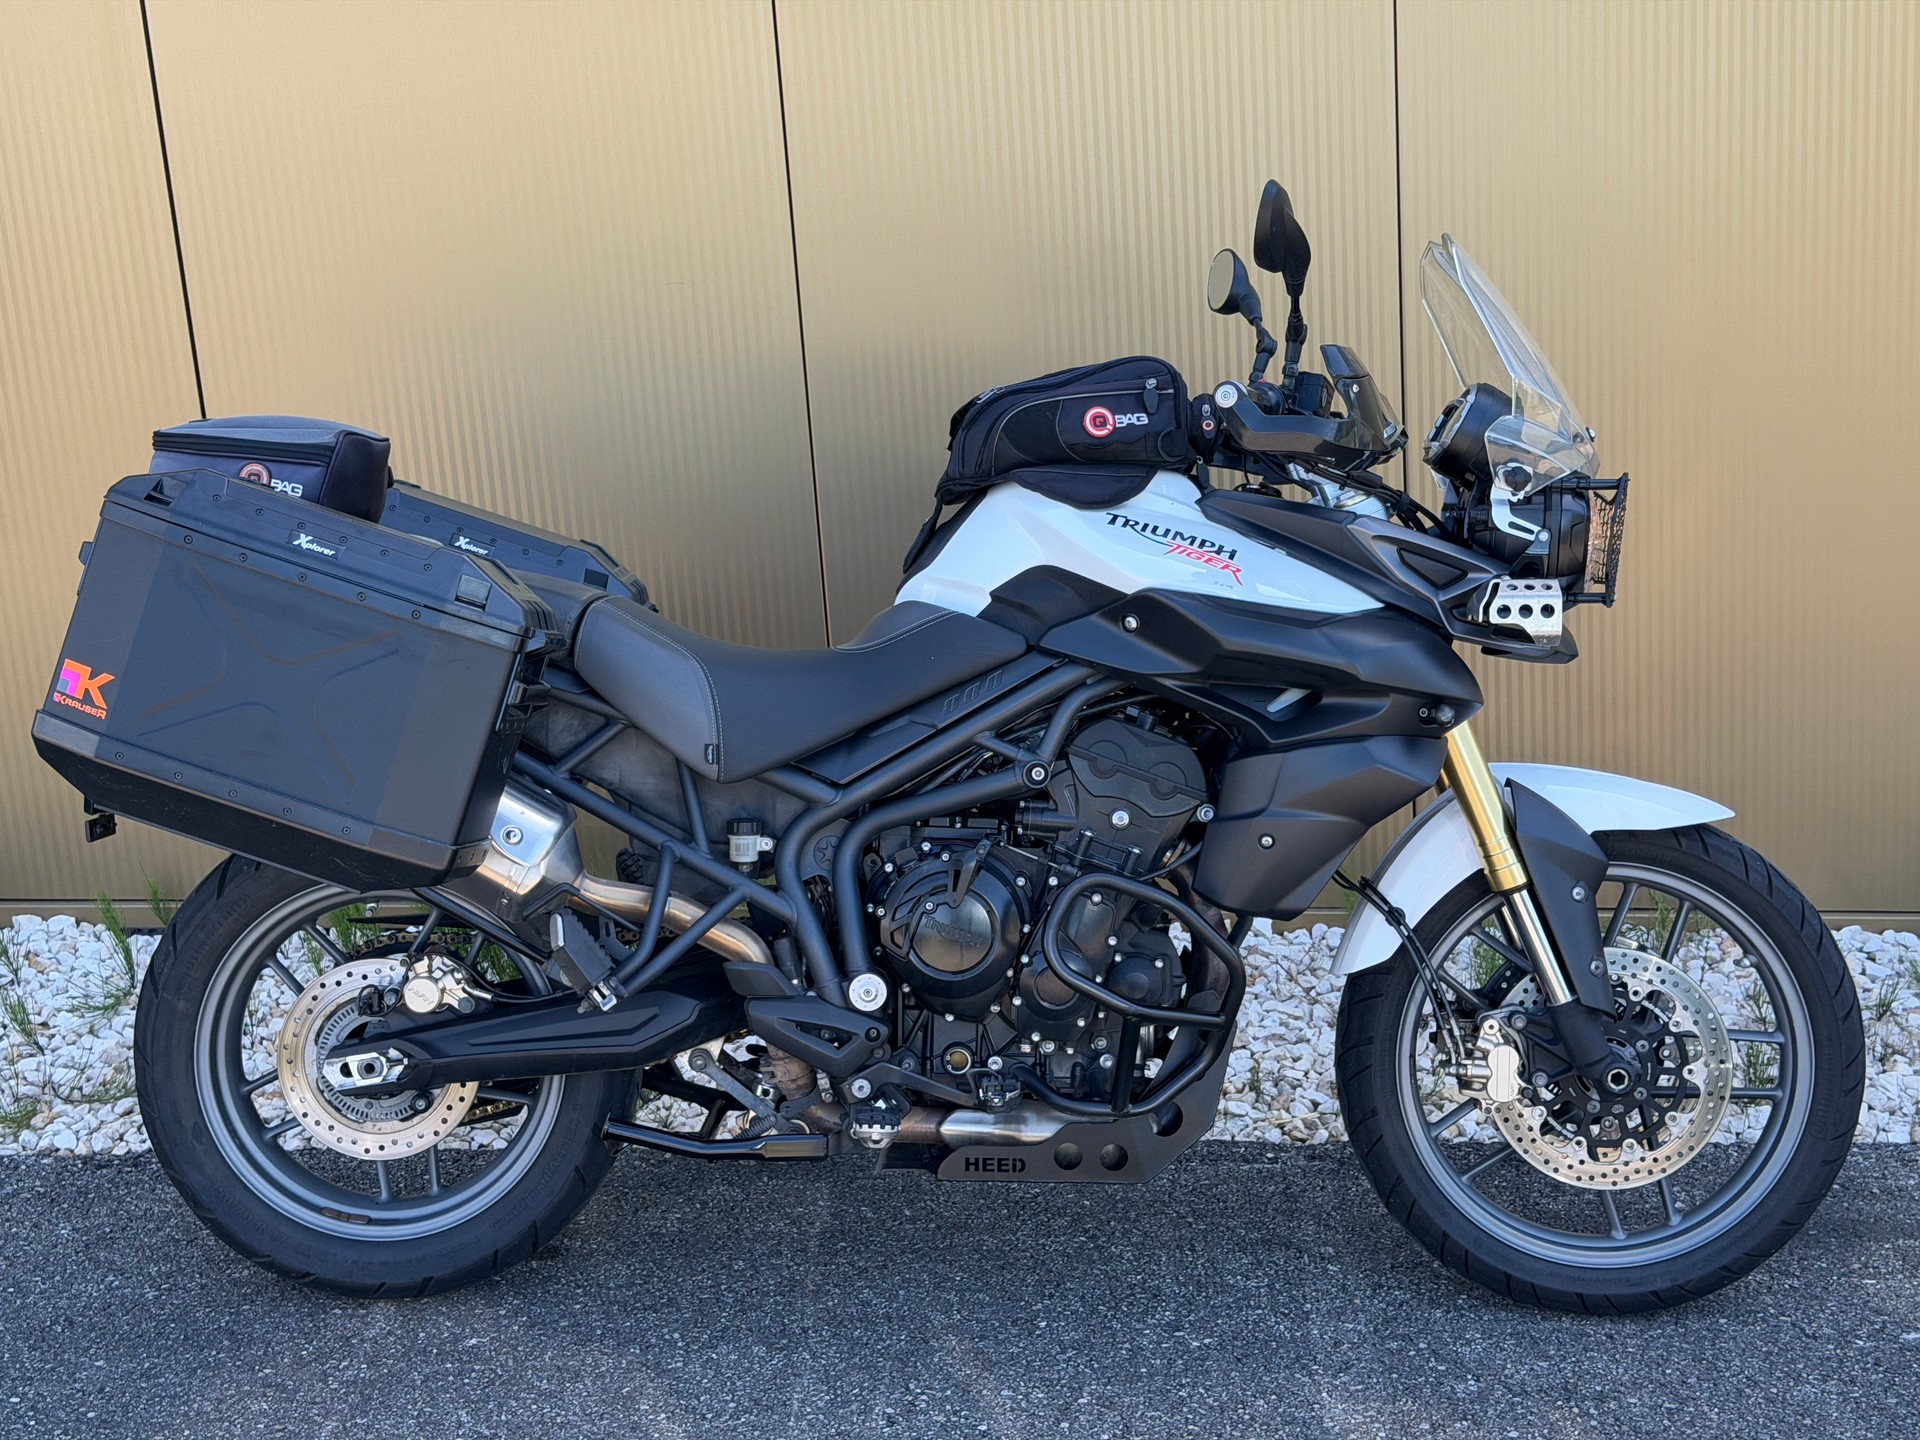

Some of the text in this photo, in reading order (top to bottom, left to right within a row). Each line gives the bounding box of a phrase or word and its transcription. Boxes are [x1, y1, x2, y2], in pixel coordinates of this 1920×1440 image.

[1115, 413, 1149, 428] BAG
[270, 478, 304, 498] BAG
[292, 533, 336, 557] Xplorer
[453, 535, 489, 555] Xplorer
[1106, 512, 1238, 561] TRIUMPH
[1163, 540, 1244, 587] TIGER
[53, 691, 107, 720] KRAUSER
[964, 1157, 1027, 1174] HEED
